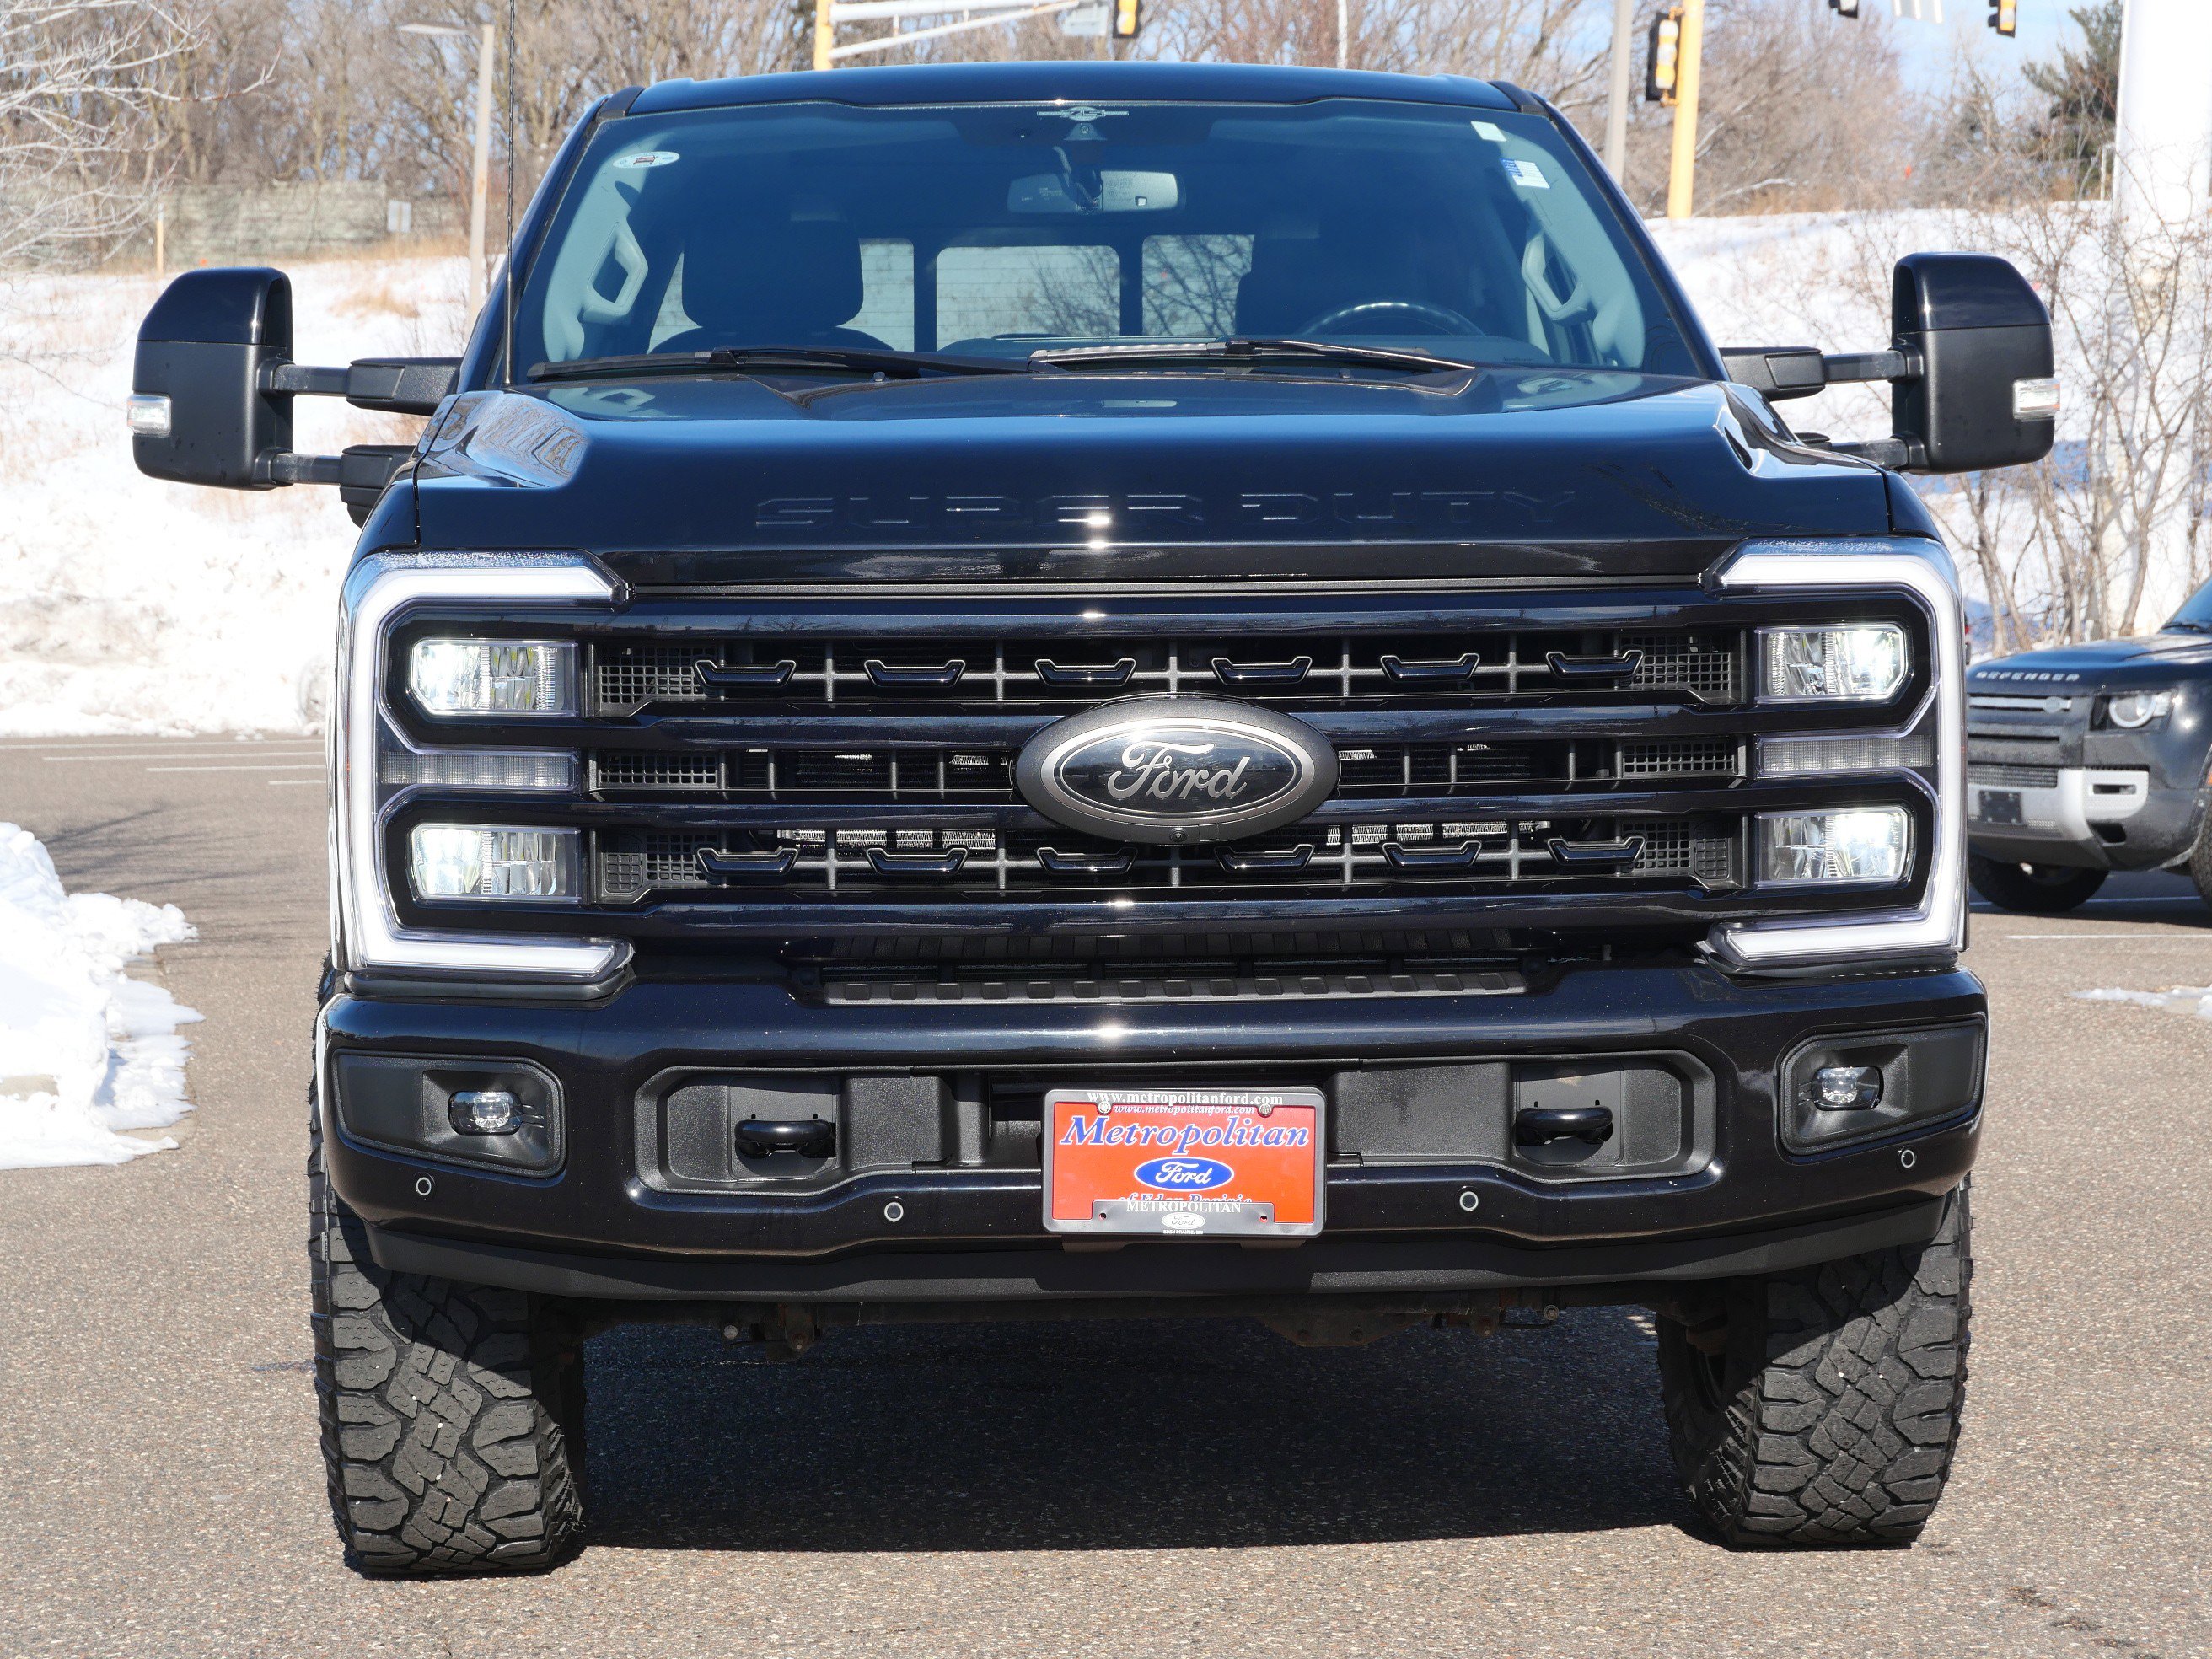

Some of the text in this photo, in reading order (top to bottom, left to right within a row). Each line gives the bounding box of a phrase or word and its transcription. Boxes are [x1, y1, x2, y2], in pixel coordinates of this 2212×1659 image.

[1976, 671, 2080, 681] DEFENDER
[1107, 741, 1251, 800] Ford
[1087, 1092, 1283, 1108] www.metropolitanford.com
[1060, 1114, 1309, 1155] Metropolitan
[1155, 1162, 1213, 1184] Ford
[1126, 1201, 1242, 1213] METROPOLITAN
[1171, 1215, 1196, 1226] Ford
